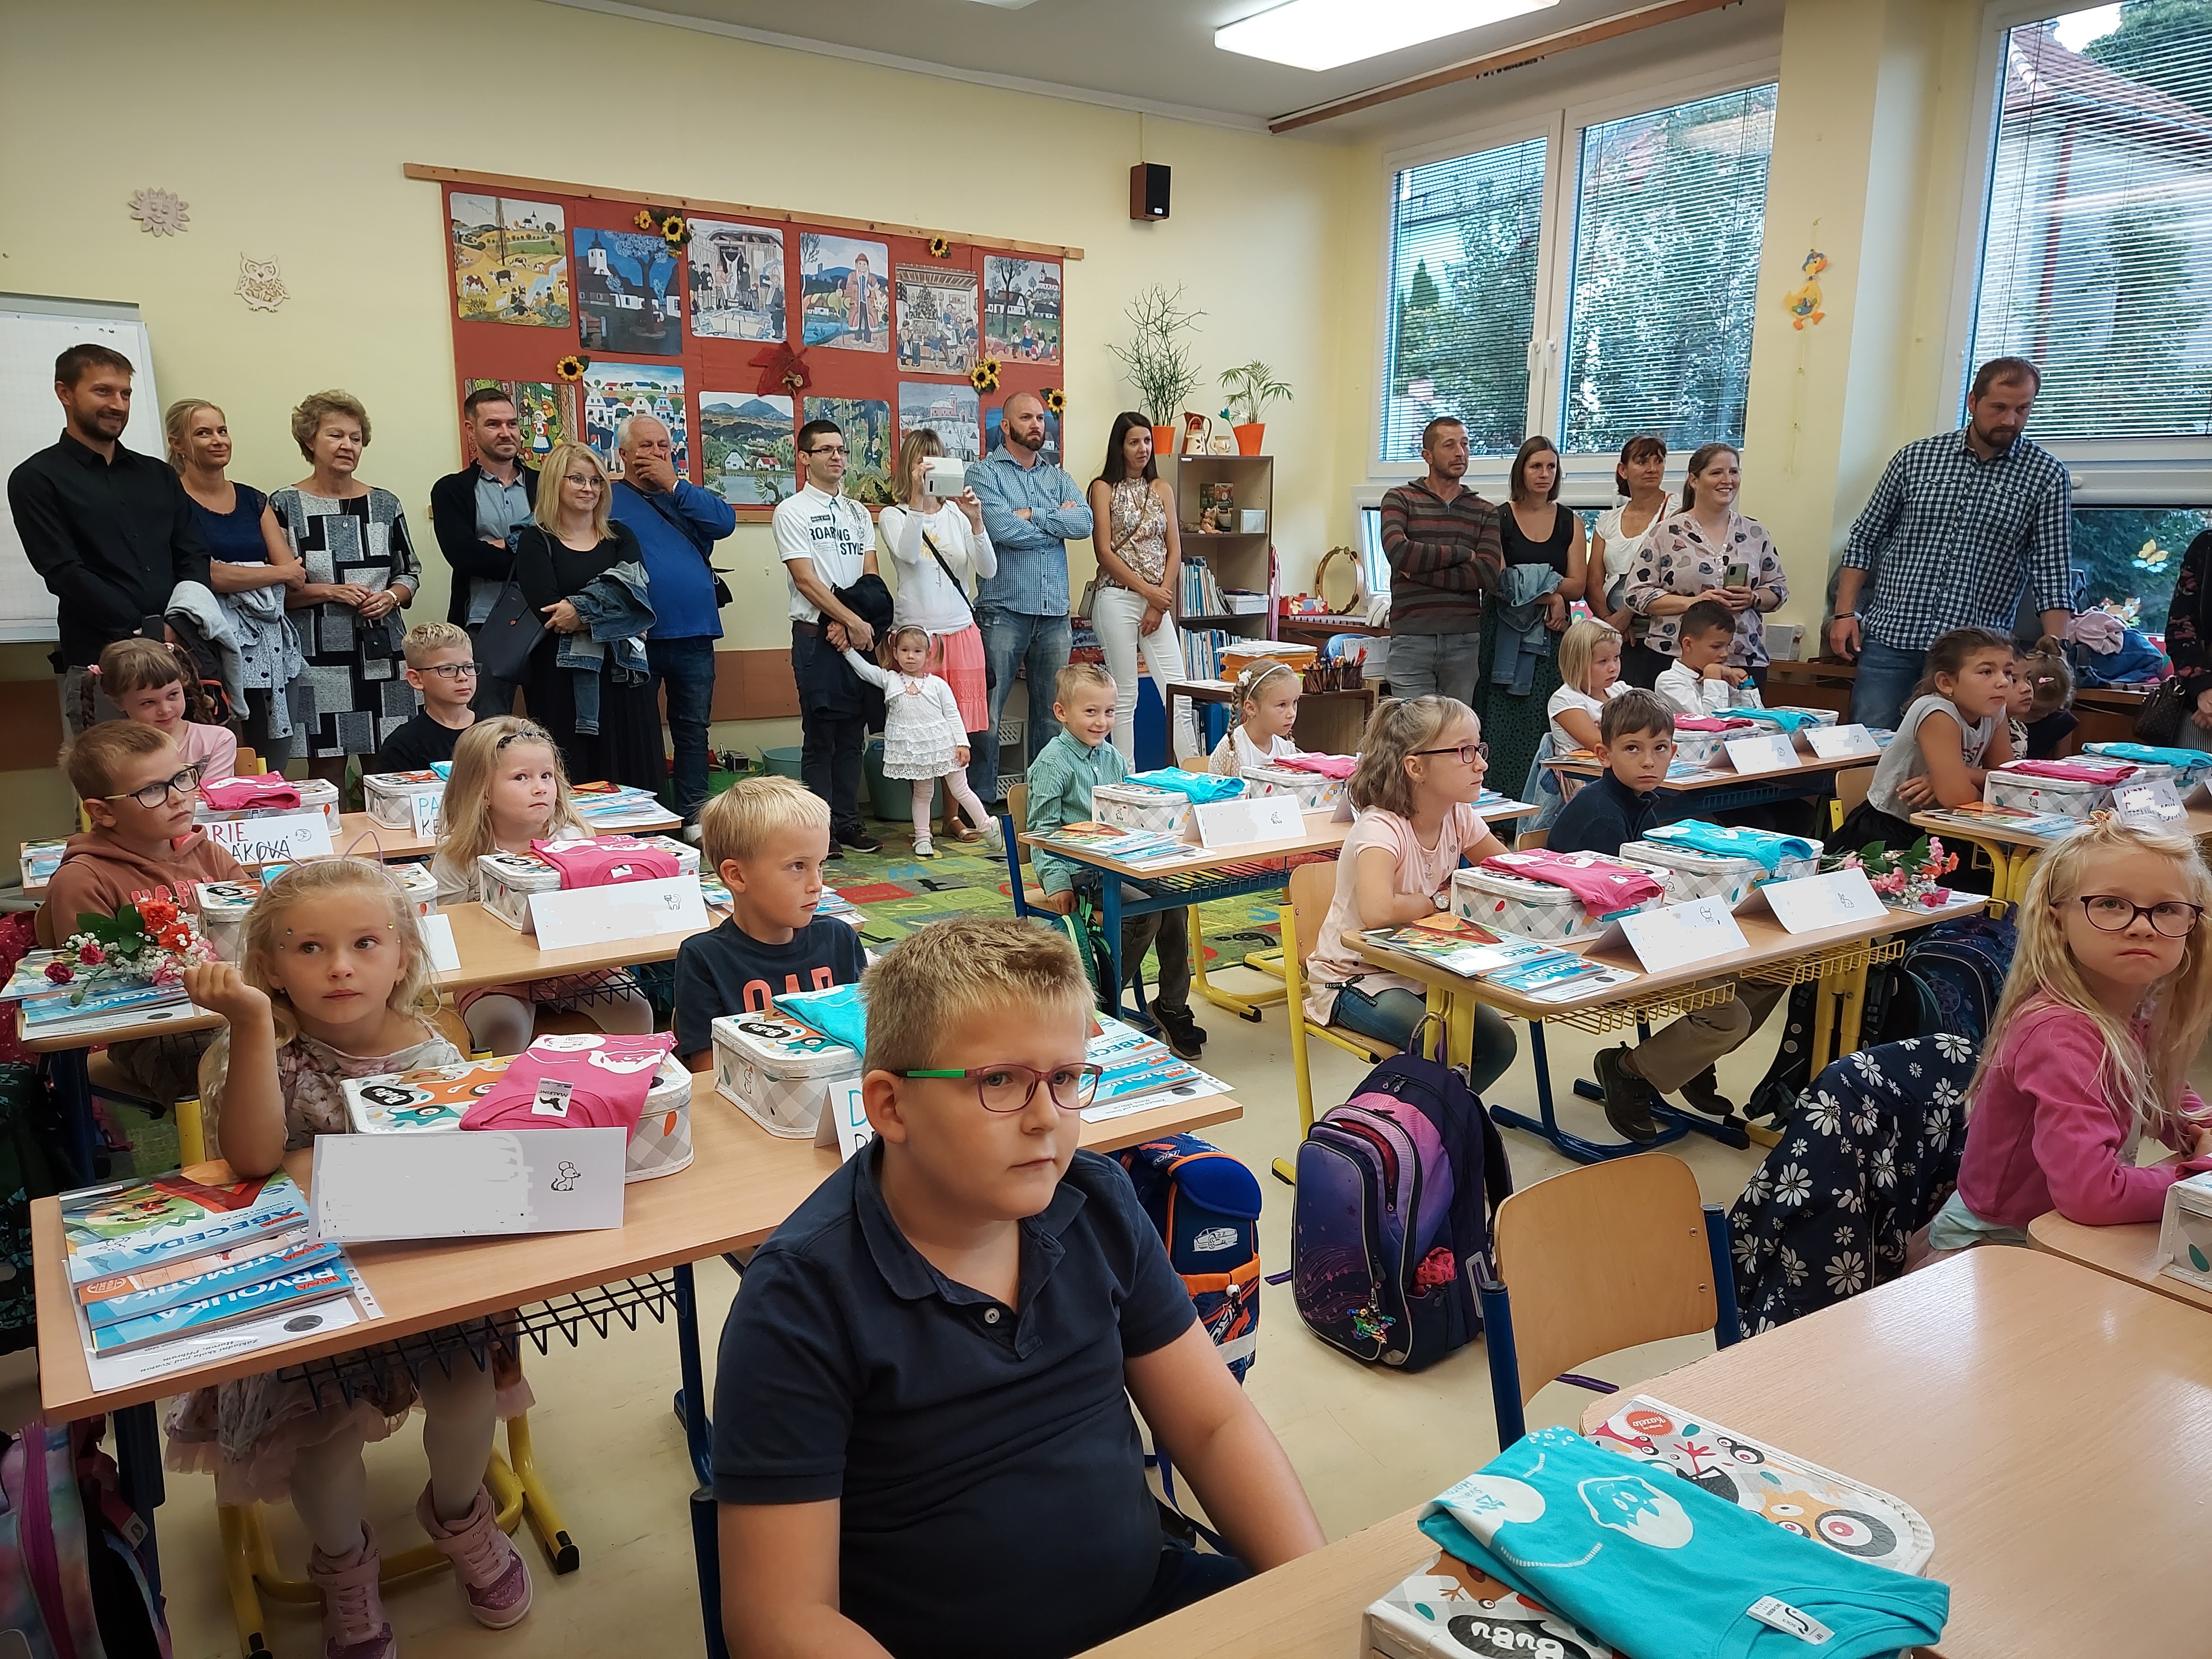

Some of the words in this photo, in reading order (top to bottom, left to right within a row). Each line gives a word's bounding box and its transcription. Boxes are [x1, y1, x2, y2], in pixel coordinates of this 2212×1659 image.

[809, 527, 851, 541] ROARNG
[840, 542, 864, 555] STYLE
[747, 1024, 783, 1037] BuBu
[372, 1088, 407, 1104] BuBu
[133, 1207, 295, 1255] ABECEDA
[157, 1267, 336, 1319] PRVOUKA
[1632, 1416, 1666, 1427] Kazelo
[1442, 1481, 1473, 1496] Horo
[1460, 1487, 1483, 1500] Sva
[1471, 1622, 1565, 1659] BuBu
